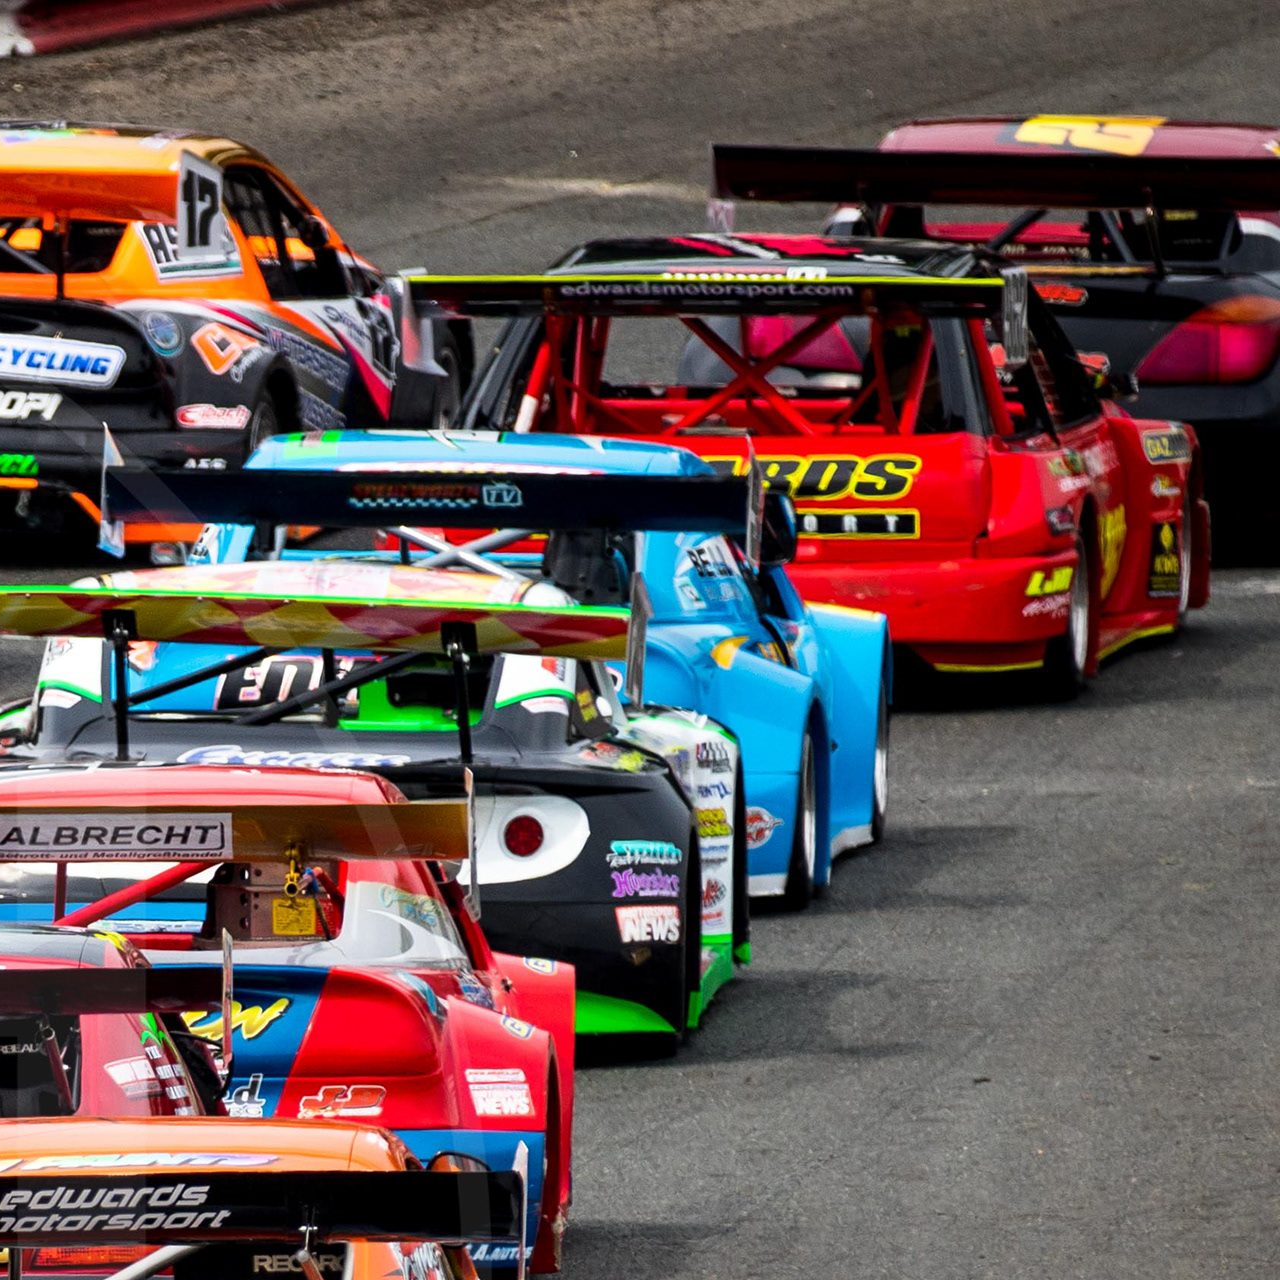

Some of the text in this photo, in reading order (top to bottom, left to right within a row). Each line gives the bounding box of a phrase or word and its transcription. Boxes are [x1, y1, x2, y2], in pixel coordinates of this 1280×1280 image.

[181, 168, 221, 248] 17
[559, 283, 854, 301] edwardsmotorsport.com
[0, 826, 228, 848] ALBRECHT
